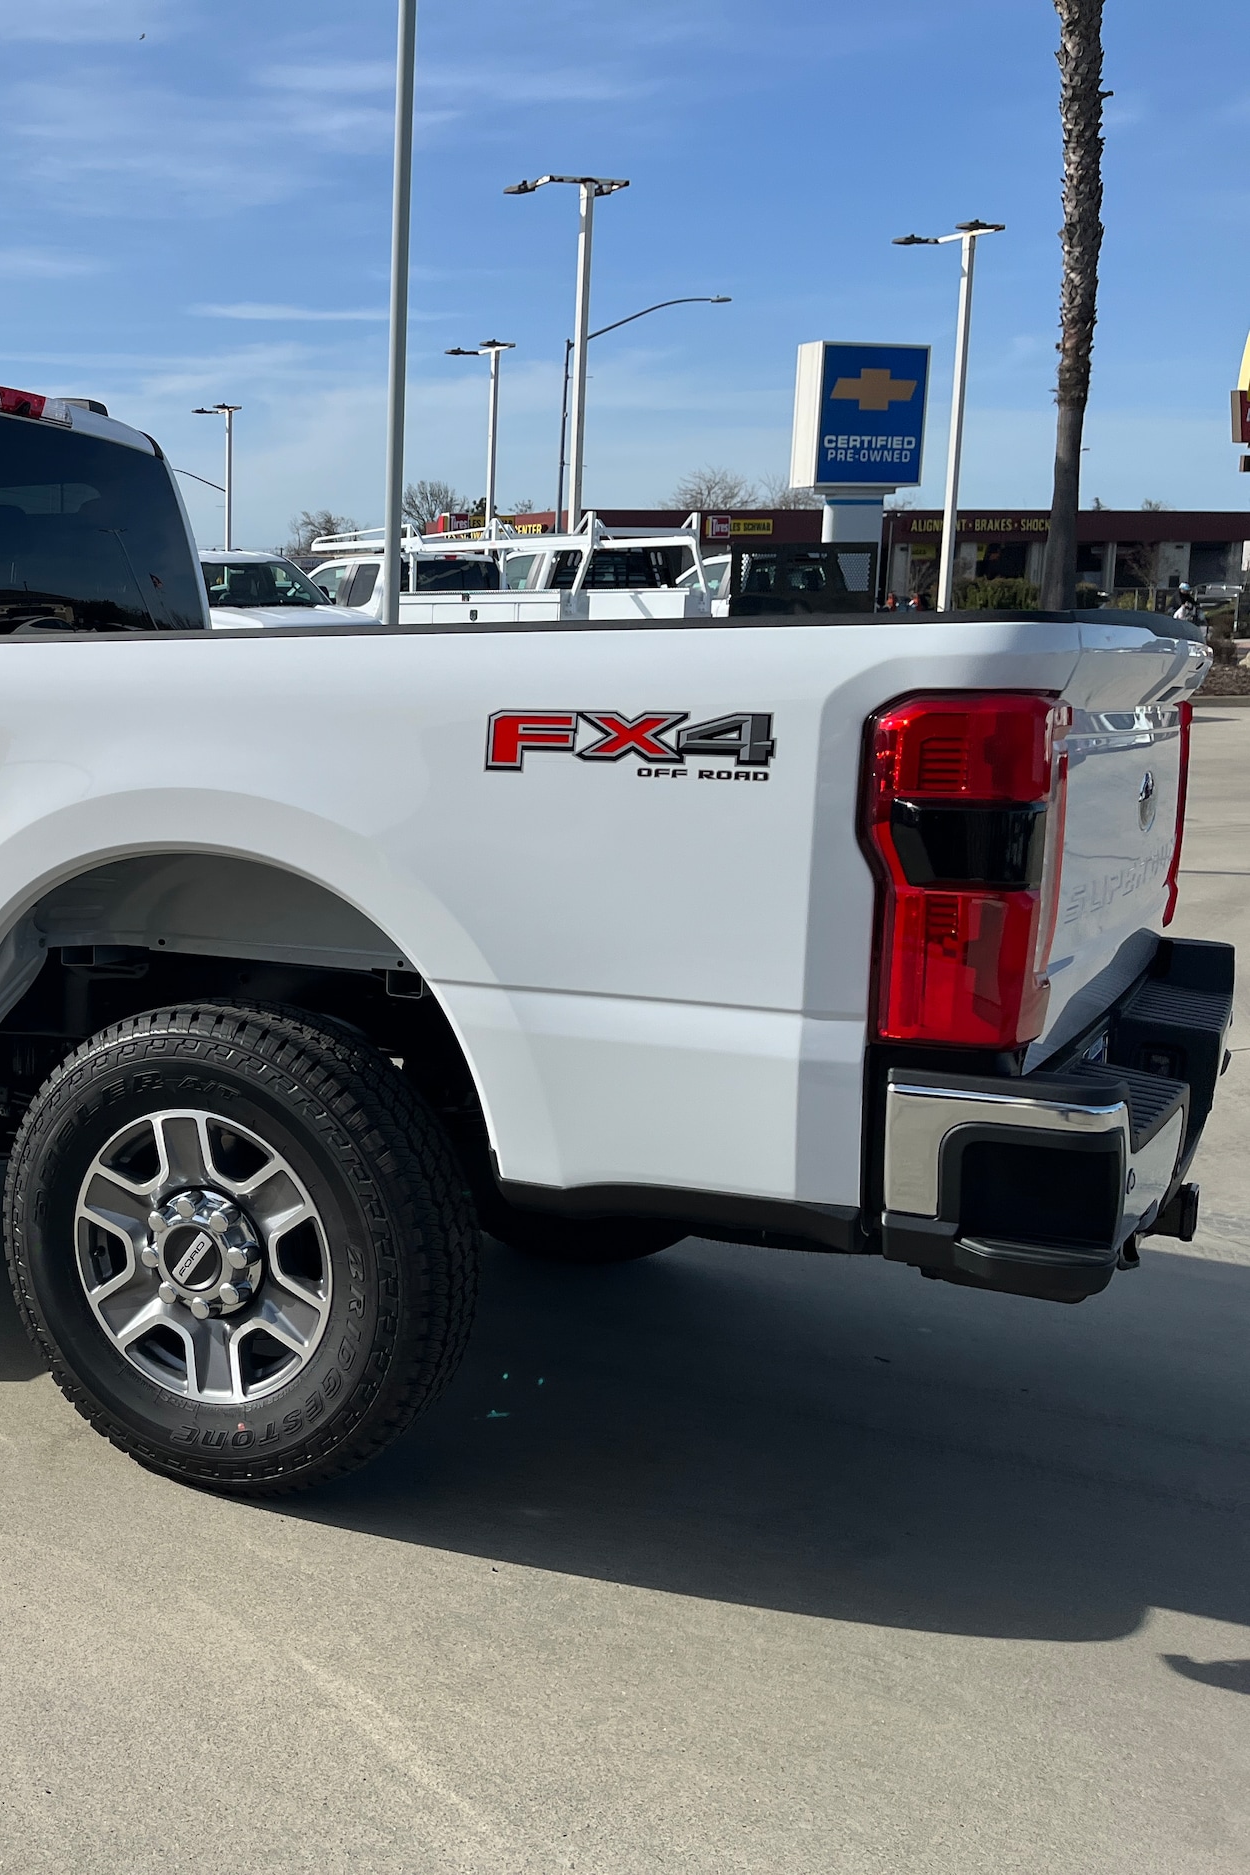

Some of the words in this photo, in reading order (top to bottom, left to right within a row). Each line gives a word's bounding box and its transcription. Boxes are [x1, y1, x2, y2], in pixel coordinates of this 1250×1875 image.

[823, 435, 916, 449] CERTIFIED
[827, 449, 911, 462] PRE-OWNED
[450, 515, 469, 531] Tires
[712, 519, 730, 535] Tires
[743, 523, 771, 531] SCHWAB
[974, 519, 1012, 532] BRAKES
[484, 709, 778, 773] FX4
[637, 767, 688, 779] OFF
[698, 768, 770, 782] ROAD
[176, 1075, 240, 1100] A/T
[178, 1241, 205, 1277] FORD
[170, 1243, 366, 1451] BRIDGESTONE
